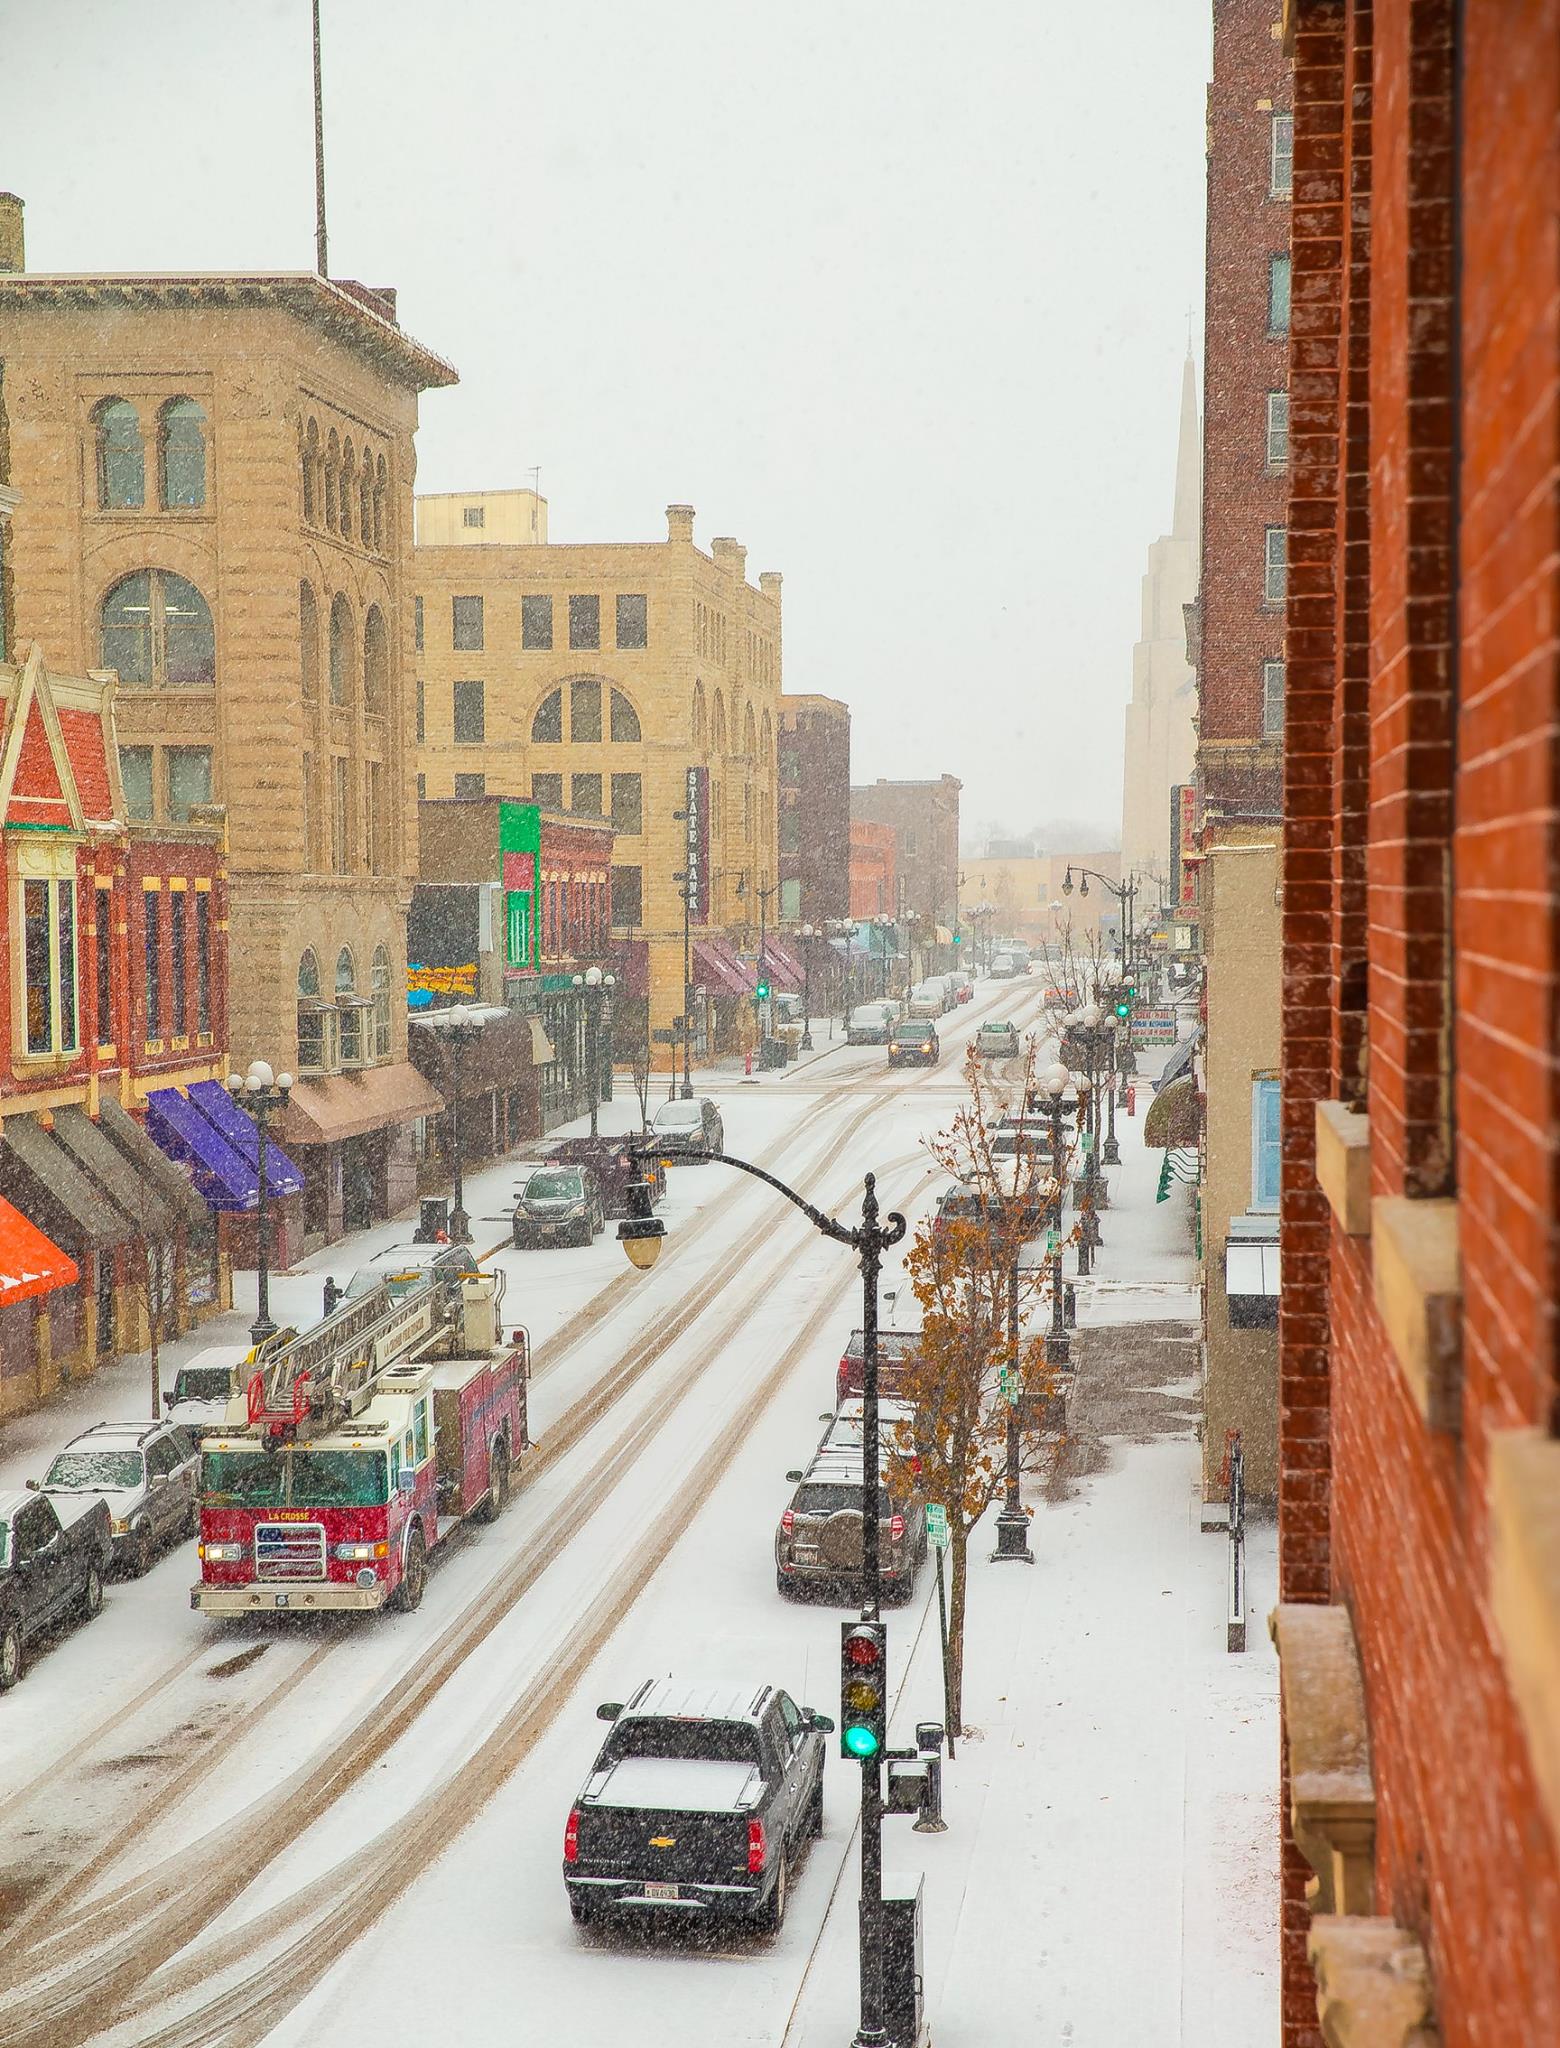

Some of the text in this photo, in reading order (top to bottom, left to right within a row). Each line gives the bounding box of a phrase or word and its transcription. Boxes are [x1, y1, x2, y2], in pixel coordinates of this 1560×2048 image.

[688, 771, 698, 909] STATE BANK
[268, 1512, 310, 1521] LA CROSSE
